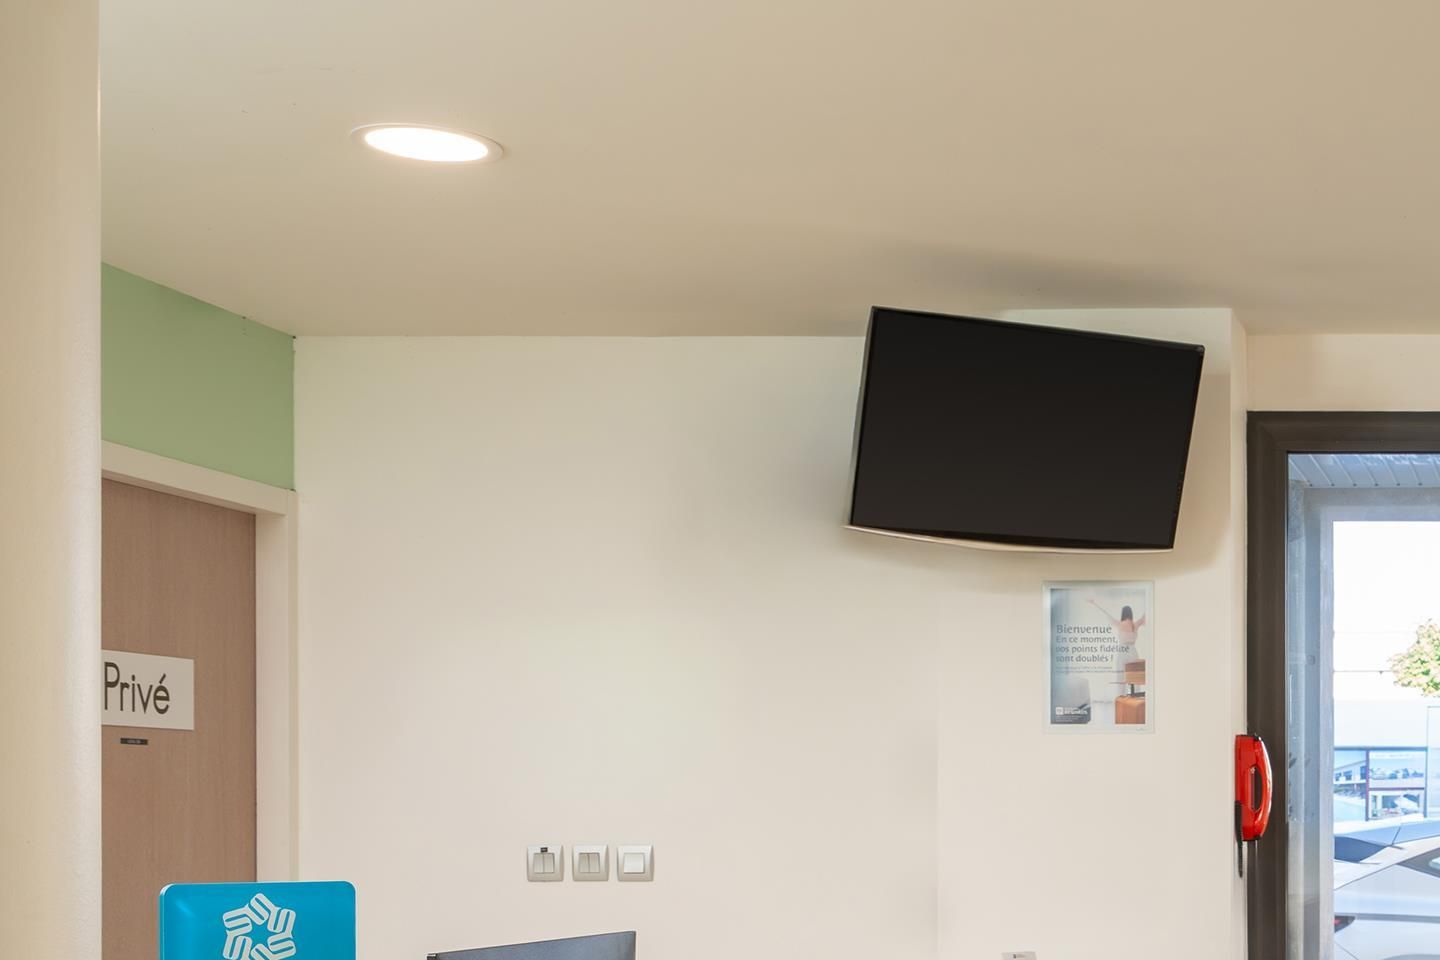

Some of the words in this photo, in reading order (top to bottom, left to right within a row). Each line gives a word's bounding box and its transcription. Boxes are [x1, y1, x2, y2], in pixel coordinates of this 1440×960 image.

[1056, 624, 1112, 634] Bienvenue
[1056, 635, 1067, 643] En
[1080, 636, 1118, 644] moment,
[1072, 644, 1098, 653] points
[1100, 644, 1130, 653] fidélité
[1056, 655, 1074, 663] sont
[1075, 654, 1109, 663] doublés
[104, 661, 171, 715] Privé
